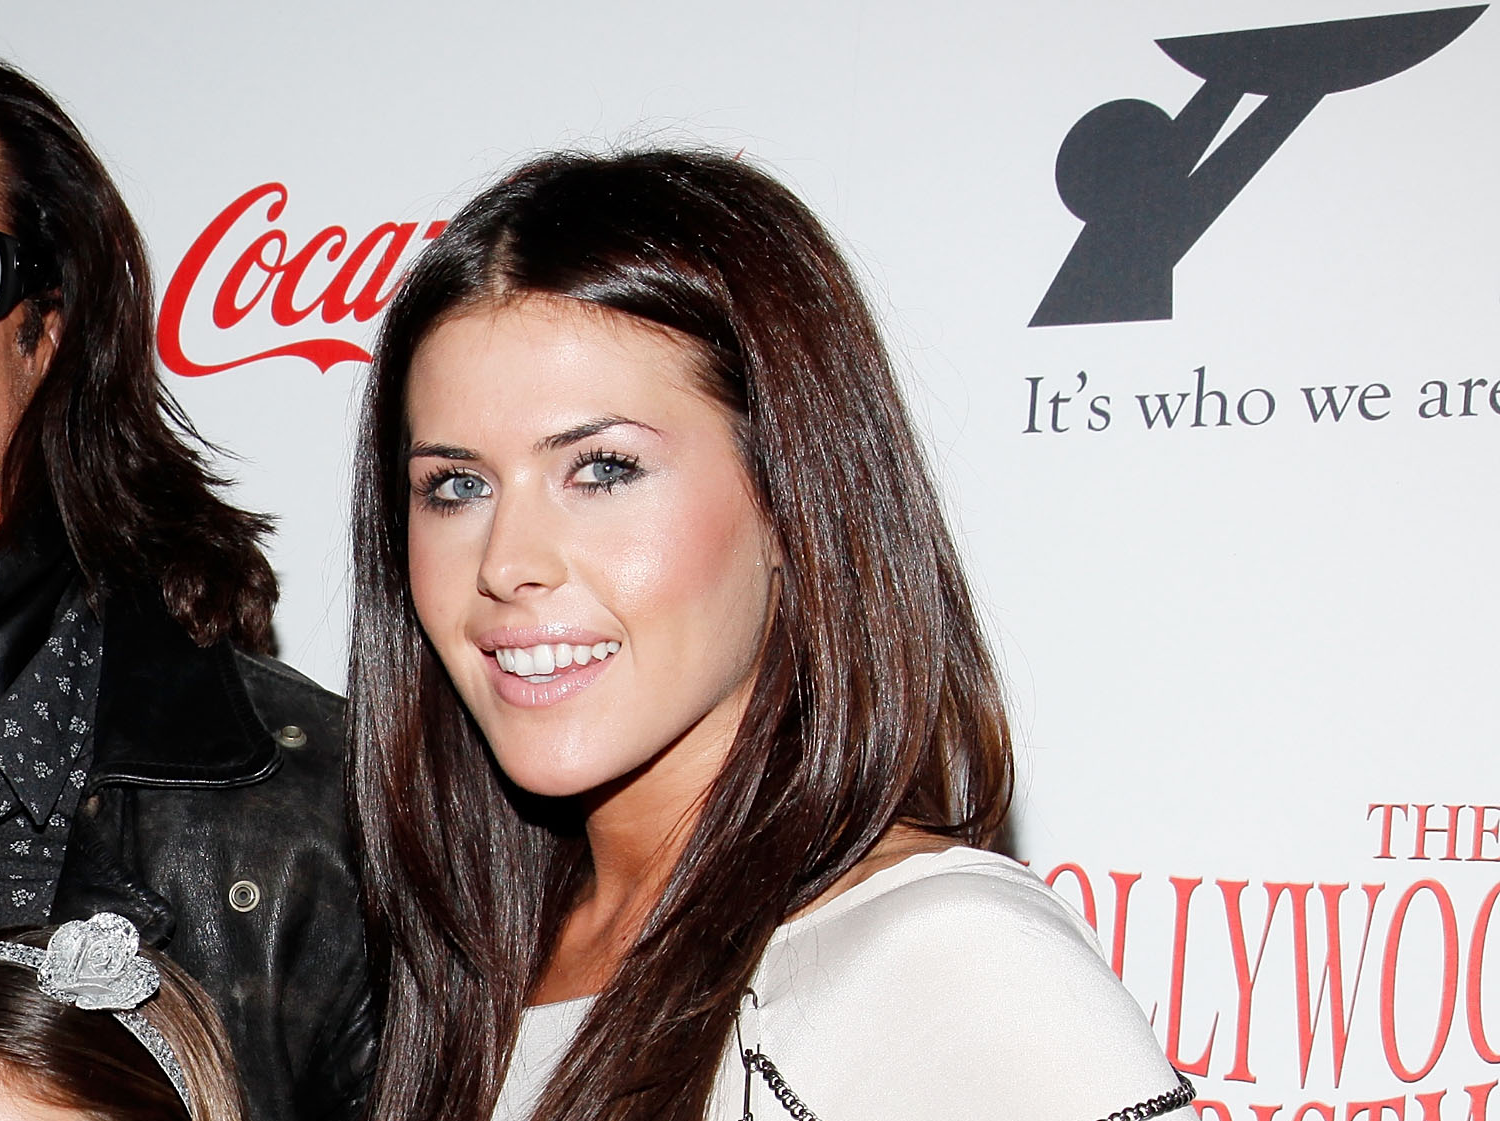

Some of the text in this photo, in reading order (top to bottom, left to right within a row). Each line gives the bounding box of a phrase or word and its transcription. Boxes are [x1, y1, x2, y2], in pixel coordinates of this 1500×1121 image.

[1022, 371, 1112, 434] It's
[1135, 366, 1276, 430] who
[1300, 380, 1392, 424] we
[1367, 803, 1500, 863] THE
